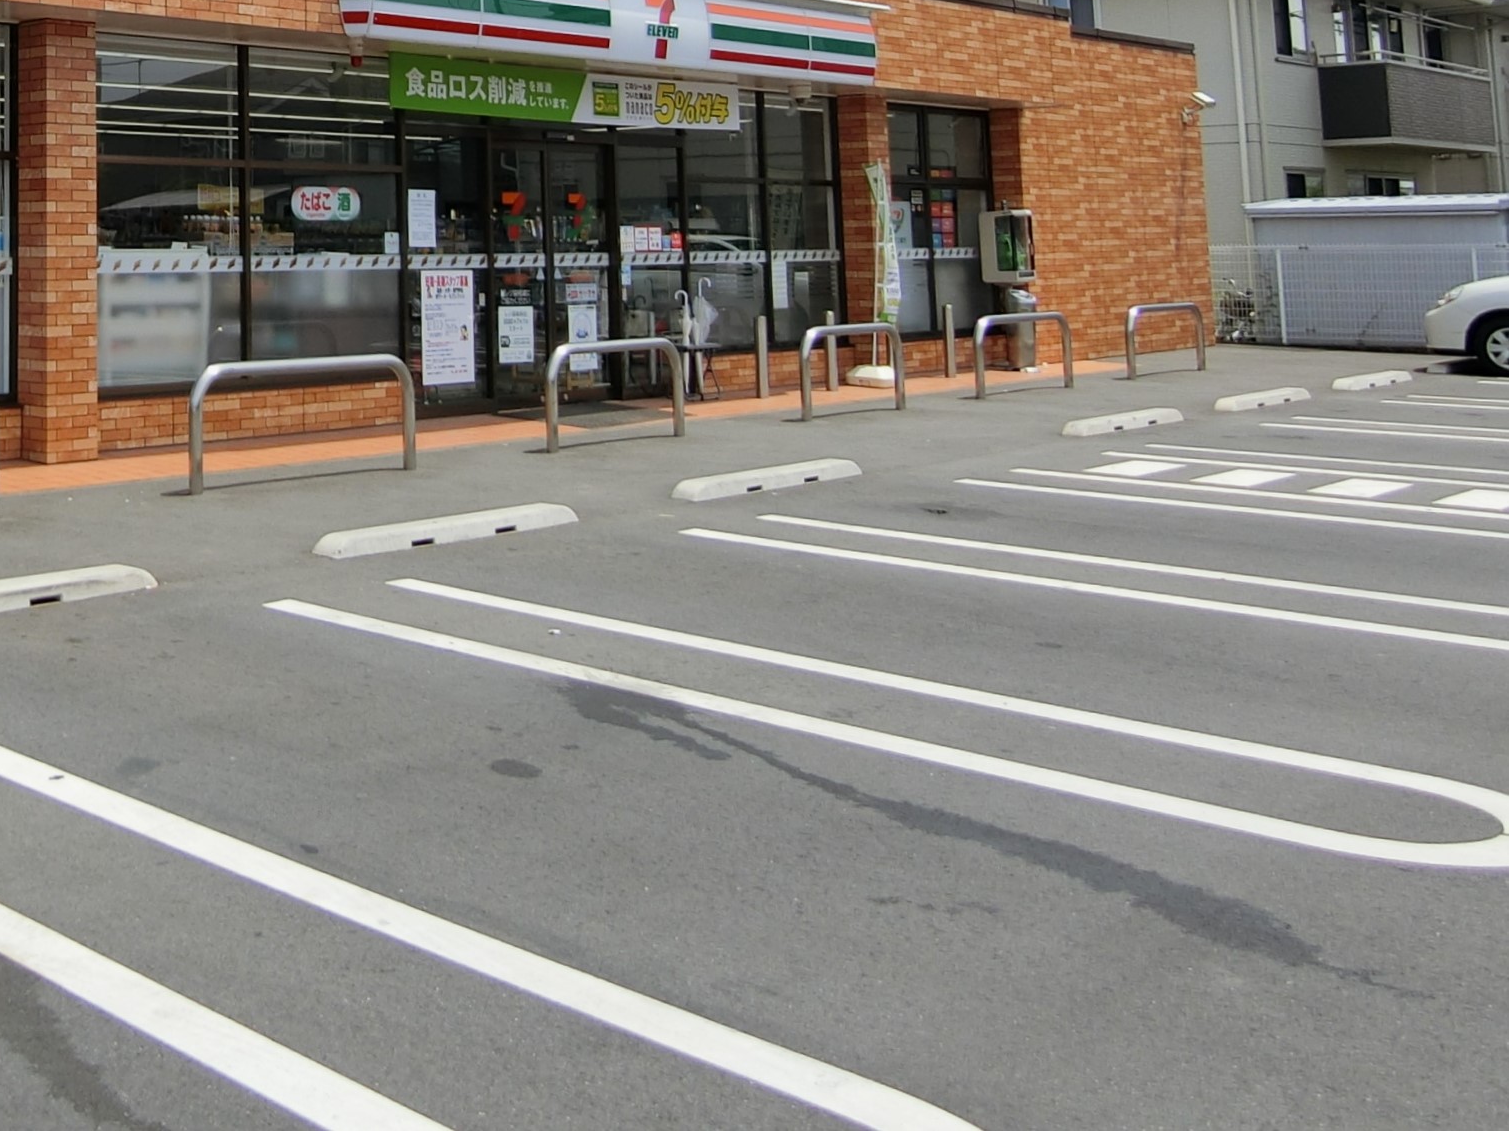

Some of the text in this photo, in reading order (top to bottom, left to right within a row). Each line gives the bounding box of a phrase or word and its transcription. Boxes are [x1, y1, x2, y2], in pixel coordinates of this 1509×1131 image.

[405, 67, 527, 107] 食品ロス削減
[530, 95, 569, 110] しています。
[626, 101, 653, 116] nanaco
[654, 82, 729, 125] 5%付与
[300, 191, 351, 212] たばこ 酒
